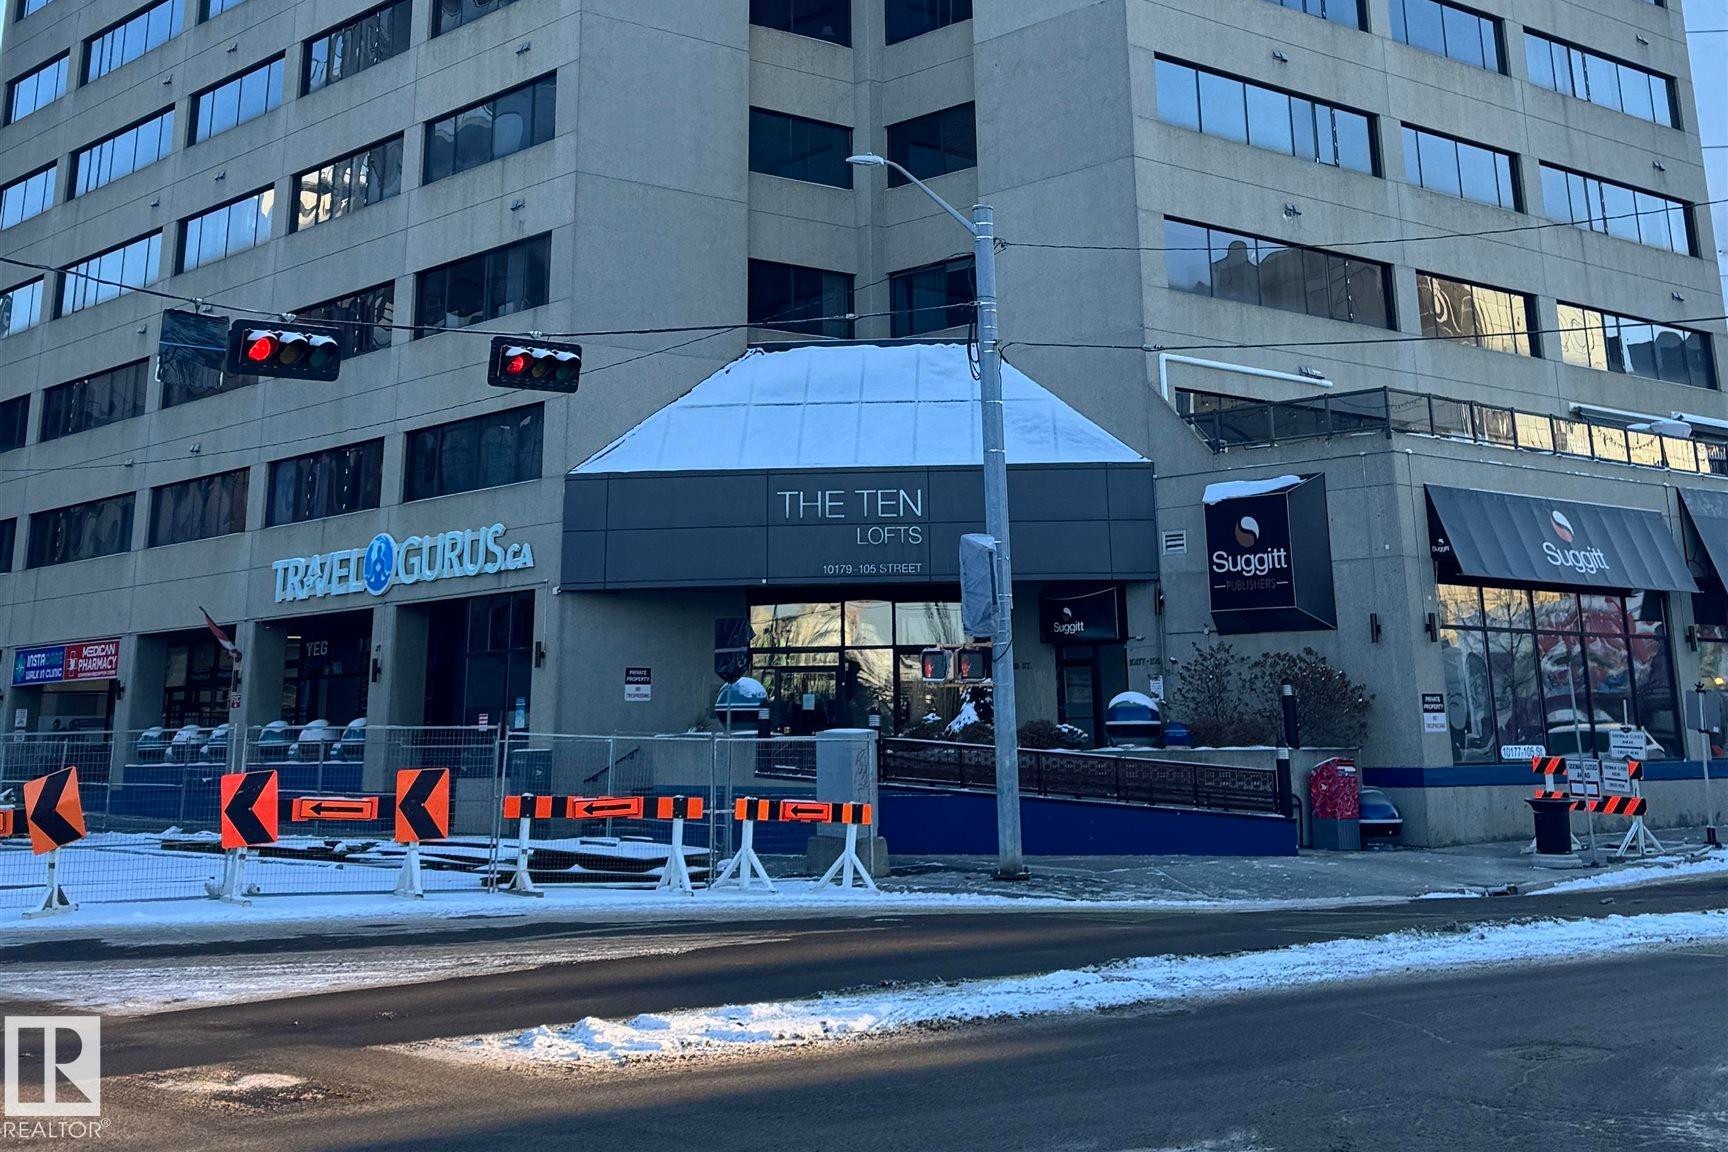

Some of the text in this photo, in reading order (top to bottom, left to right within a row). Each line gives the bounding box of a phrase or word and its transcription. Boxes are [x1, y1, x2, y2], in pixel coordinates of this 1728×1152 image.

[777, 489, 922, 519] THE TEN
[857, 526, 922, 545] LOFTS
[1212, 548, 1288, 576] Suggitt
[1542, 541, 1610, 575] Suggitt
[272, 548, 367, 603] TRAVEL
[879, 563, 922, 573] STREET
[1053, 620, 1085, 635] Suggitt
[82, 644, 116, 658] MEDICAN
[306, 640, 329, 657] YEG
[78, 656, 118, 671] PHARMACY
